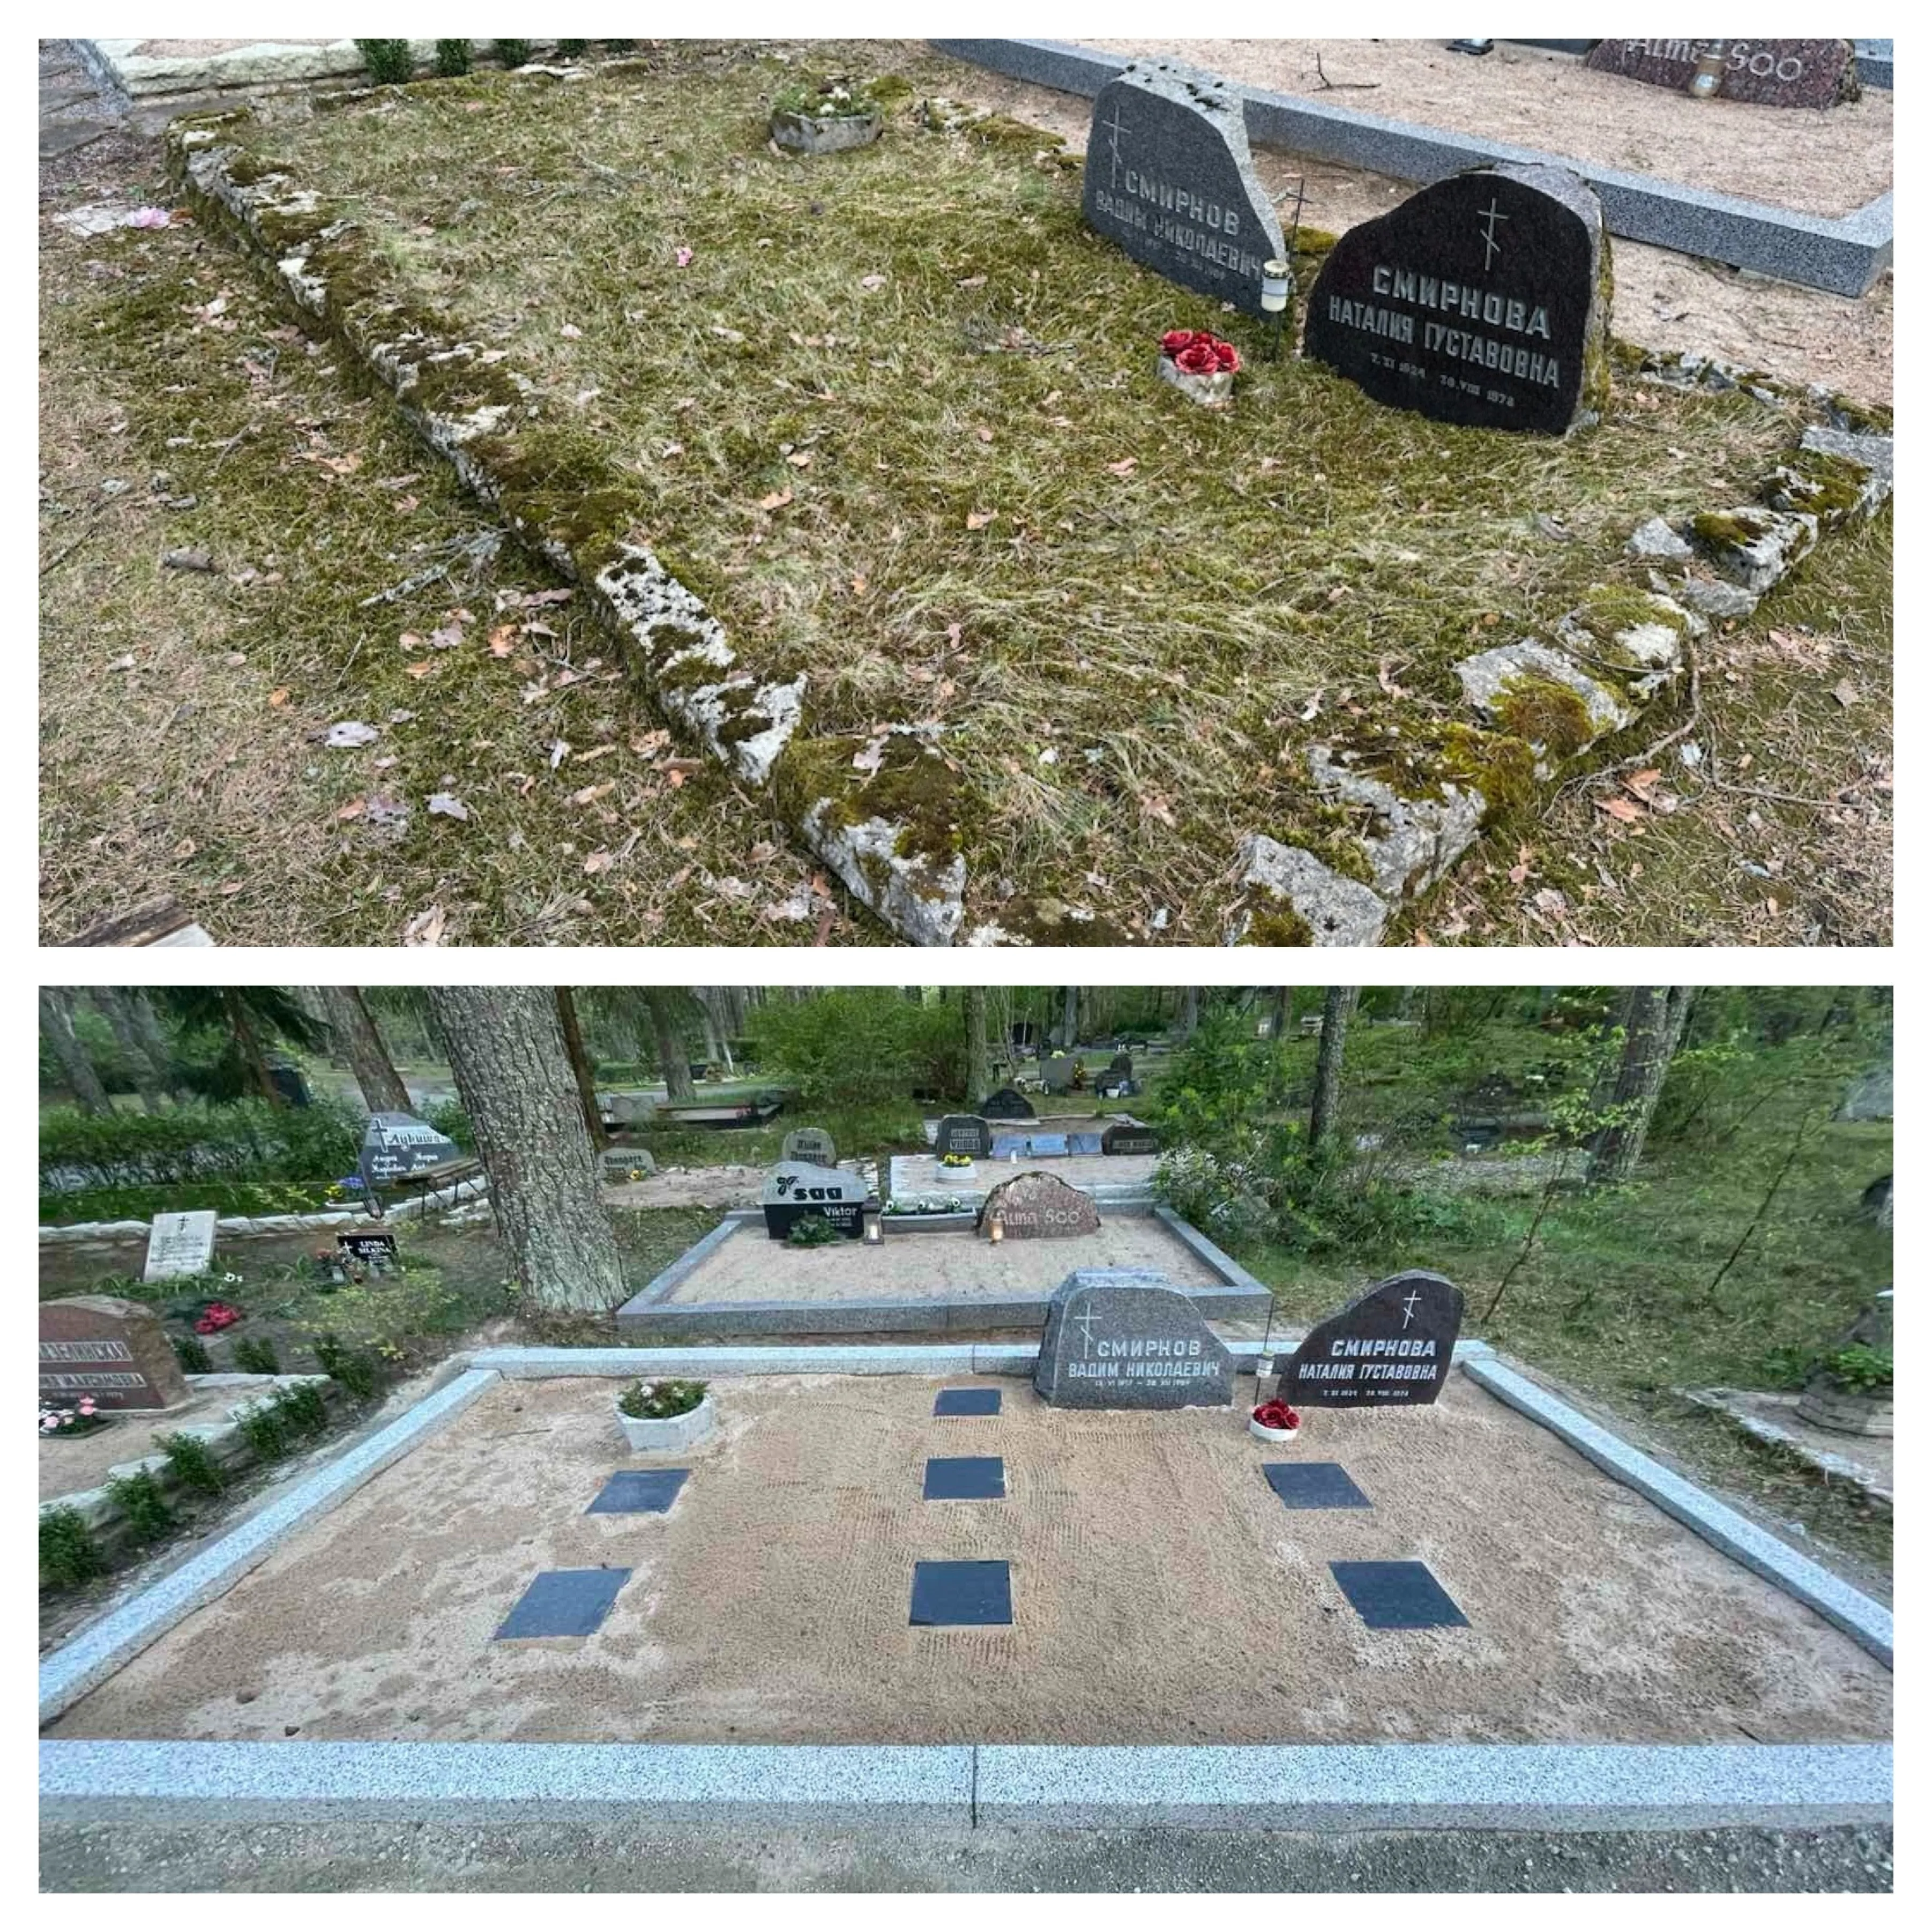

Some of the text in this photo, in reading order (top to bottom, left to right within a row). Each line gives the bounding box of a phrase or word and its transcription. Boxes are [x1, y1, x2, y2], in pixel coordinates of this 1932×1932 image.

[1125, 169, 1240, 237] СМИРНОВ
[1096, 190, 1148, 231] ВАДИМ
[1153, 215, 1260, 281] НИКОЛАЕВИЧ
[1372, 264, 1551, 341] СМИРНОВА
[1328, 294, 1561, 389] НАТАЛИЯ ГУСТАВОВНА
[823, 1206, 857, 1217] Viktor
[1098, 1339, 1201, 1357] СМИРНОВ
[1331, 1339, 1436, 1357] СМИРНОВА
[1068, 1361, 1220, 1378] ВАДИМ НИКОЛАЕВИЧ
[1299, 1363, 1438, 1381] НАТАЛИЯ ГУСТАВОВНА
